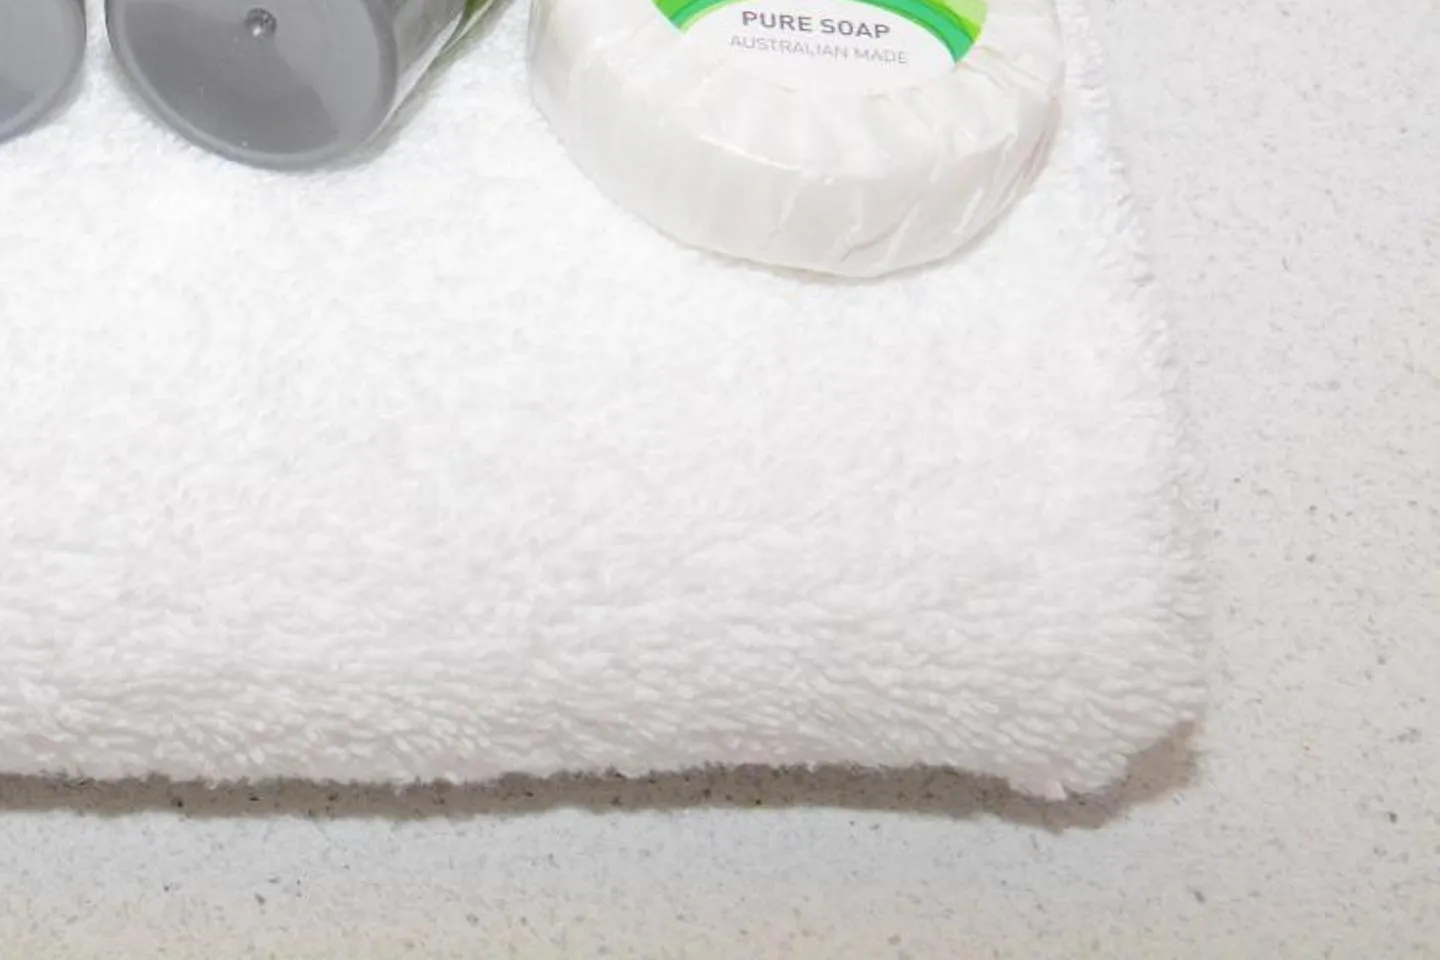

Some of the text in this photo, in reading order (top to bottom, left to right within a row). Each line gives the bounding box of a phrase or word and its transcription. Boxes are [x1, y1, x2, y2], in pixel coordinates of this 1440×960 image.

[742, 10, 890, 39] PURE SOAP
[730, 35, 908, 64] AUSTRALIAN MADE
